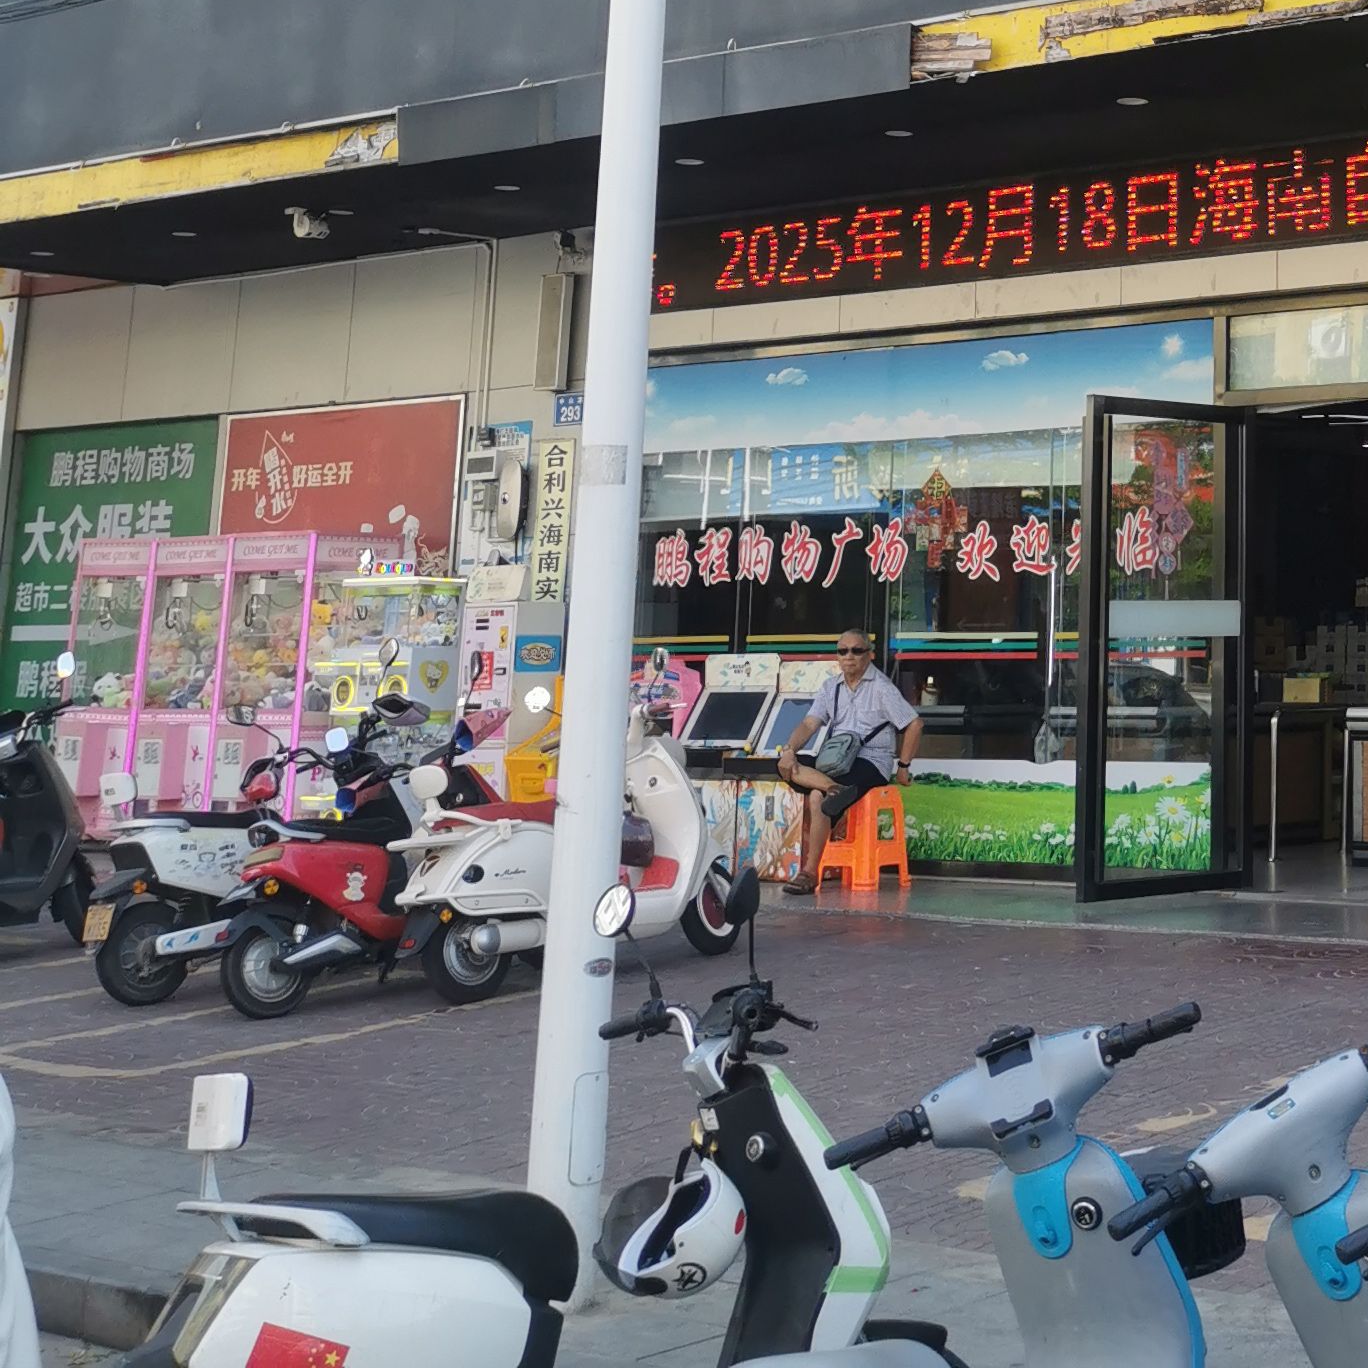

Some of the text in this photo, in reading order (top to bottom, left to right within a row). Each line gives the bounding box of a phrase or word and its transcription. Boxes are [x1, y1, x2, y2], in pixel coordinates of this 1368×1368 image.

[560, 405, 581, 422] 293
[49, 443, 196, 487] 鹏程购物商场
[231, 467, 261, 492] 开年
[291, 461, 353, 488] 好运全开
[652, 516, 909, 589] 鹏程购物广场
